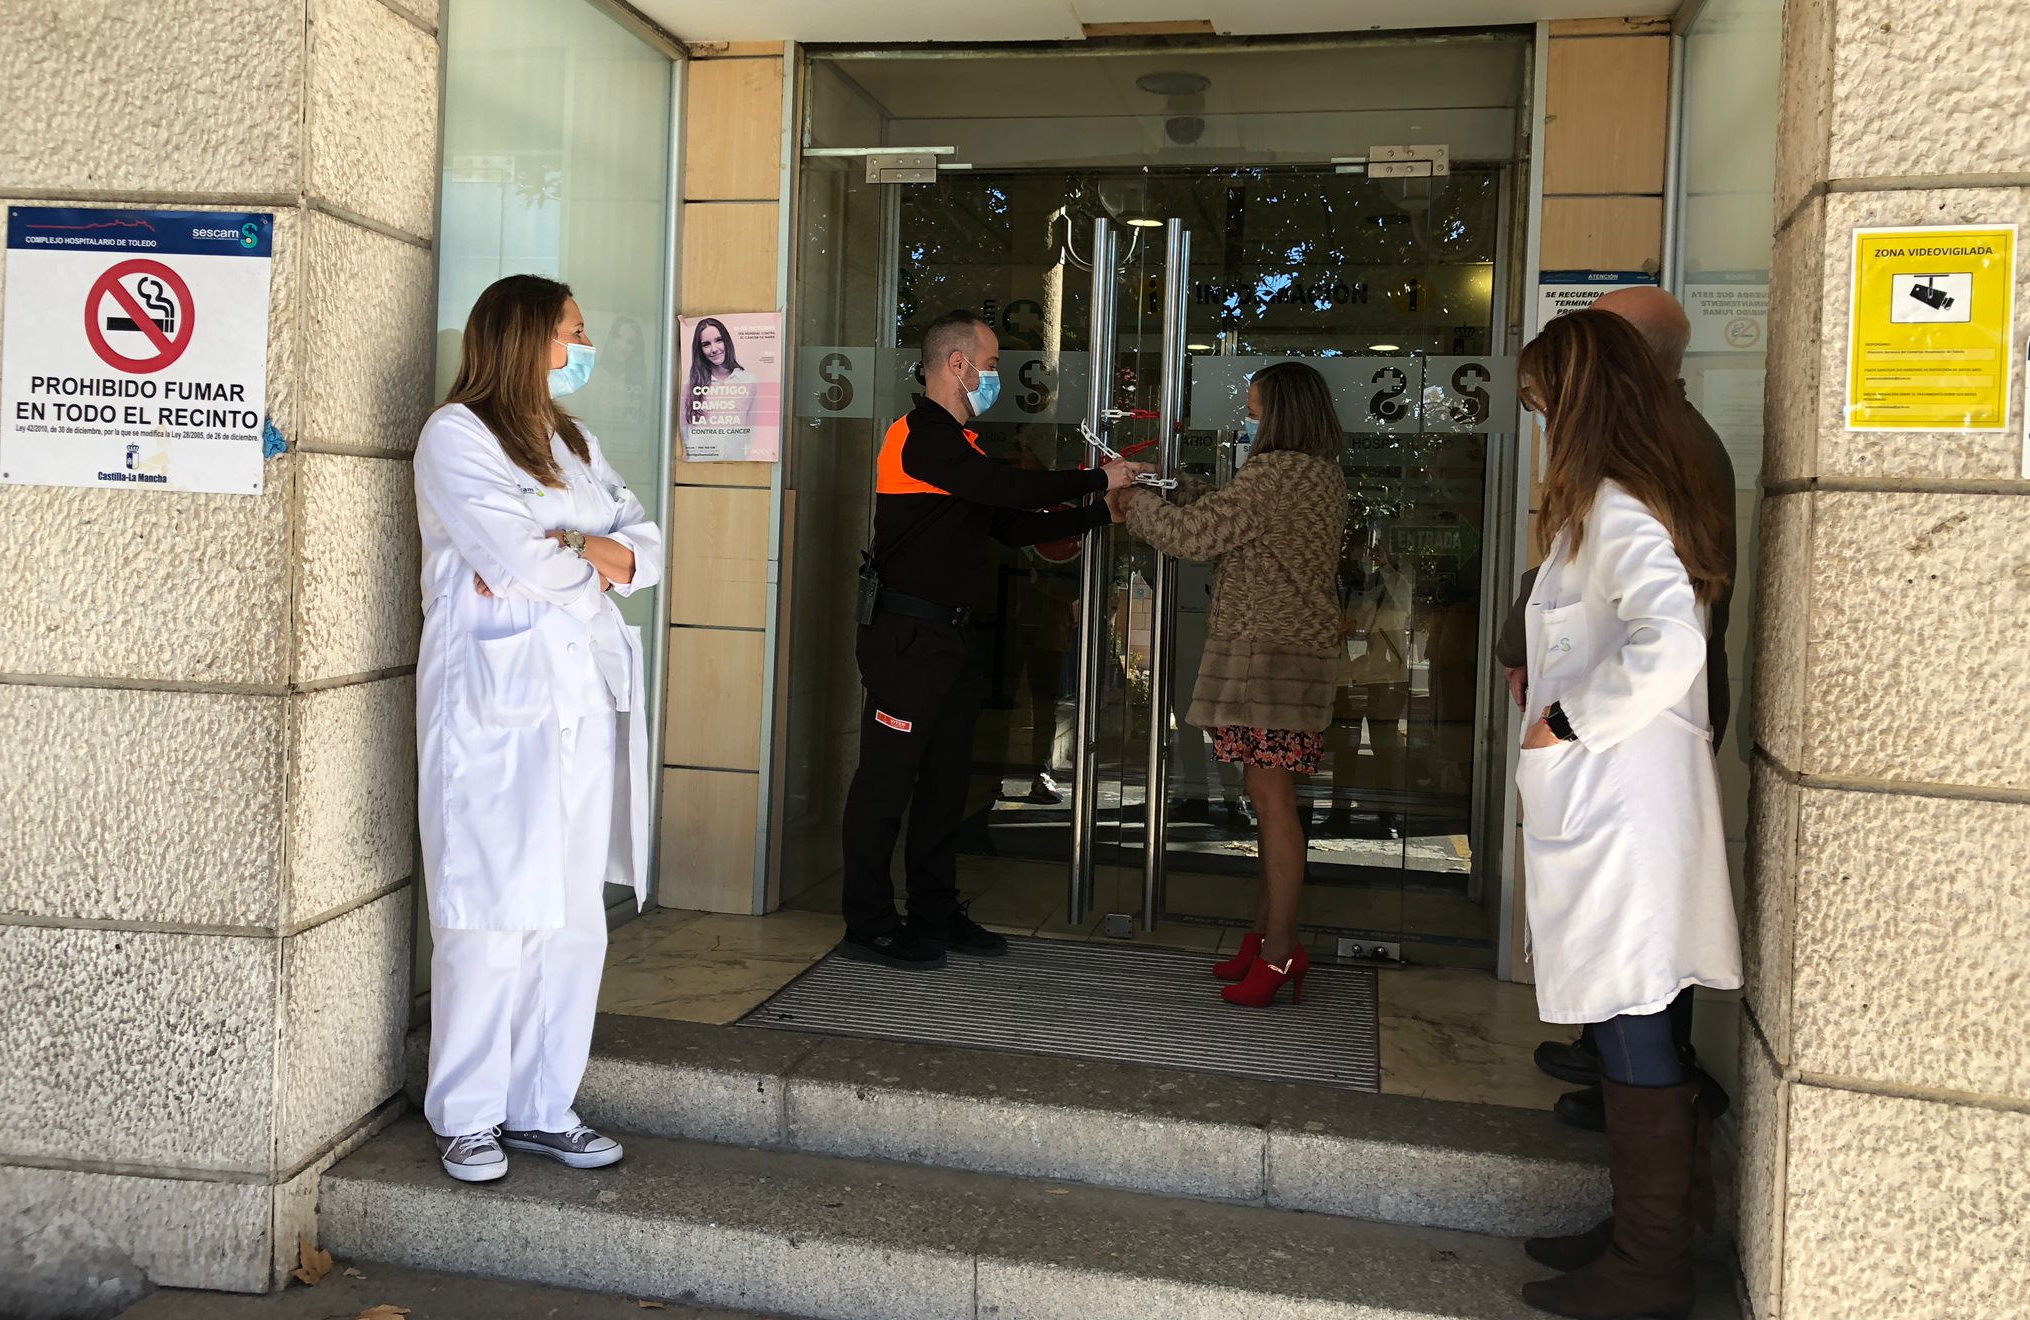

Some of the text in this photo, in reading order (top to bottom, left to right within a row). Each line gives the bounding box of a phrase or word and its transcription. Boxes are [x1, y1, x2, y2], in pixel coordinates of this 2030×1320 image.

[192, 228, 239, 238] sescam
[25, 236, 64, 244] COMPLEJO
[65, 237, 116, 246] HOSPITALARIO
[128, 239, 157, 247] TOLEDO
[1874, 246, 1993, 257] ZONA VIDEOVIGILADA
[31, 376, 245, 402] PROHIBIDO FUMAR
[692, 385, 749, 396] CONTIGO,
[692, 400, 736, 410] DAMOS
[16, 401, 259, 429] EN TODO EL RECINTO
[692, 415, 741, 425] LA CARA
[15, 424, 25, 433] Ley
[50, 425, 57, 433] de
[58, 425, 66, 433] 30
[66, 426, 73, 434] de
[104, 429, 113, 438] por
[165, 430, 171, 438] la
[171, 431, 181, 440] Ley
[206, 432, 214, 440] de
[214, 432, 222, 440] 26
[98, 471, 167, 483] Castilla-La Mancha
